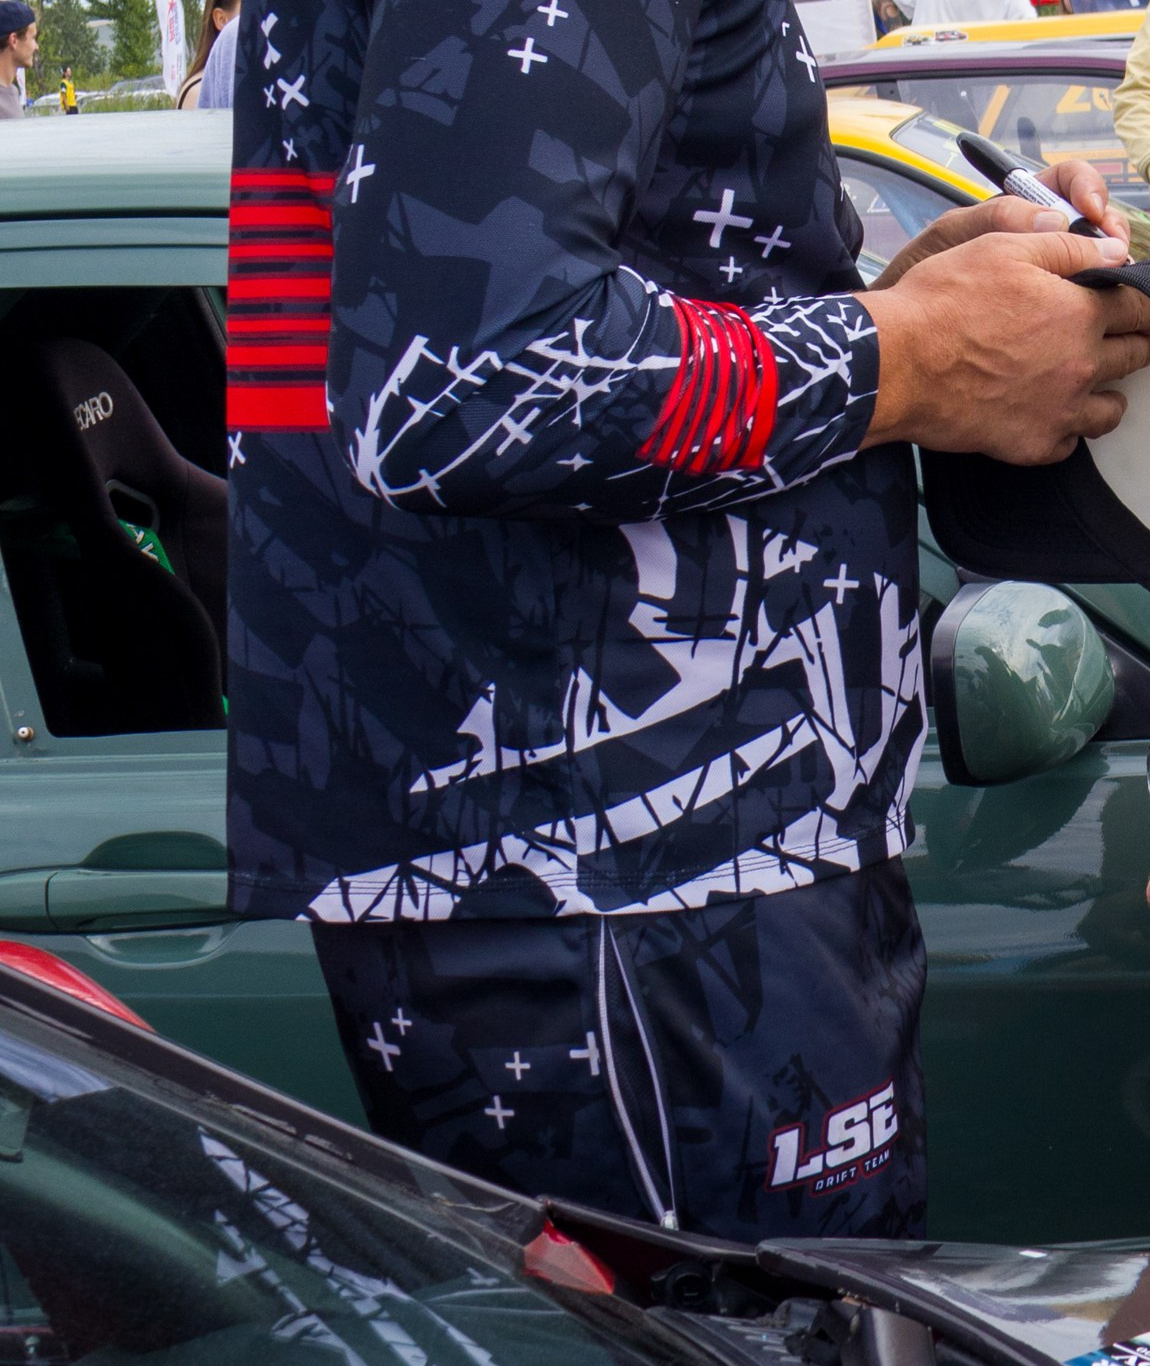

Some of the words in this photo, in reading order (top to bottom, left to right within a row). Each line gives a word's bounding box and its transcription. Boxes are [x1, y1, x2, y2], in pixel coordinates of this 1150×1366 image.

[73, 391, 114, 431] ECARO
[771, 1081, 898, 1187] LSE
[815, 1166, 857, 1191] DRIFT
[864, 1148, 891, 1172] TEAM
